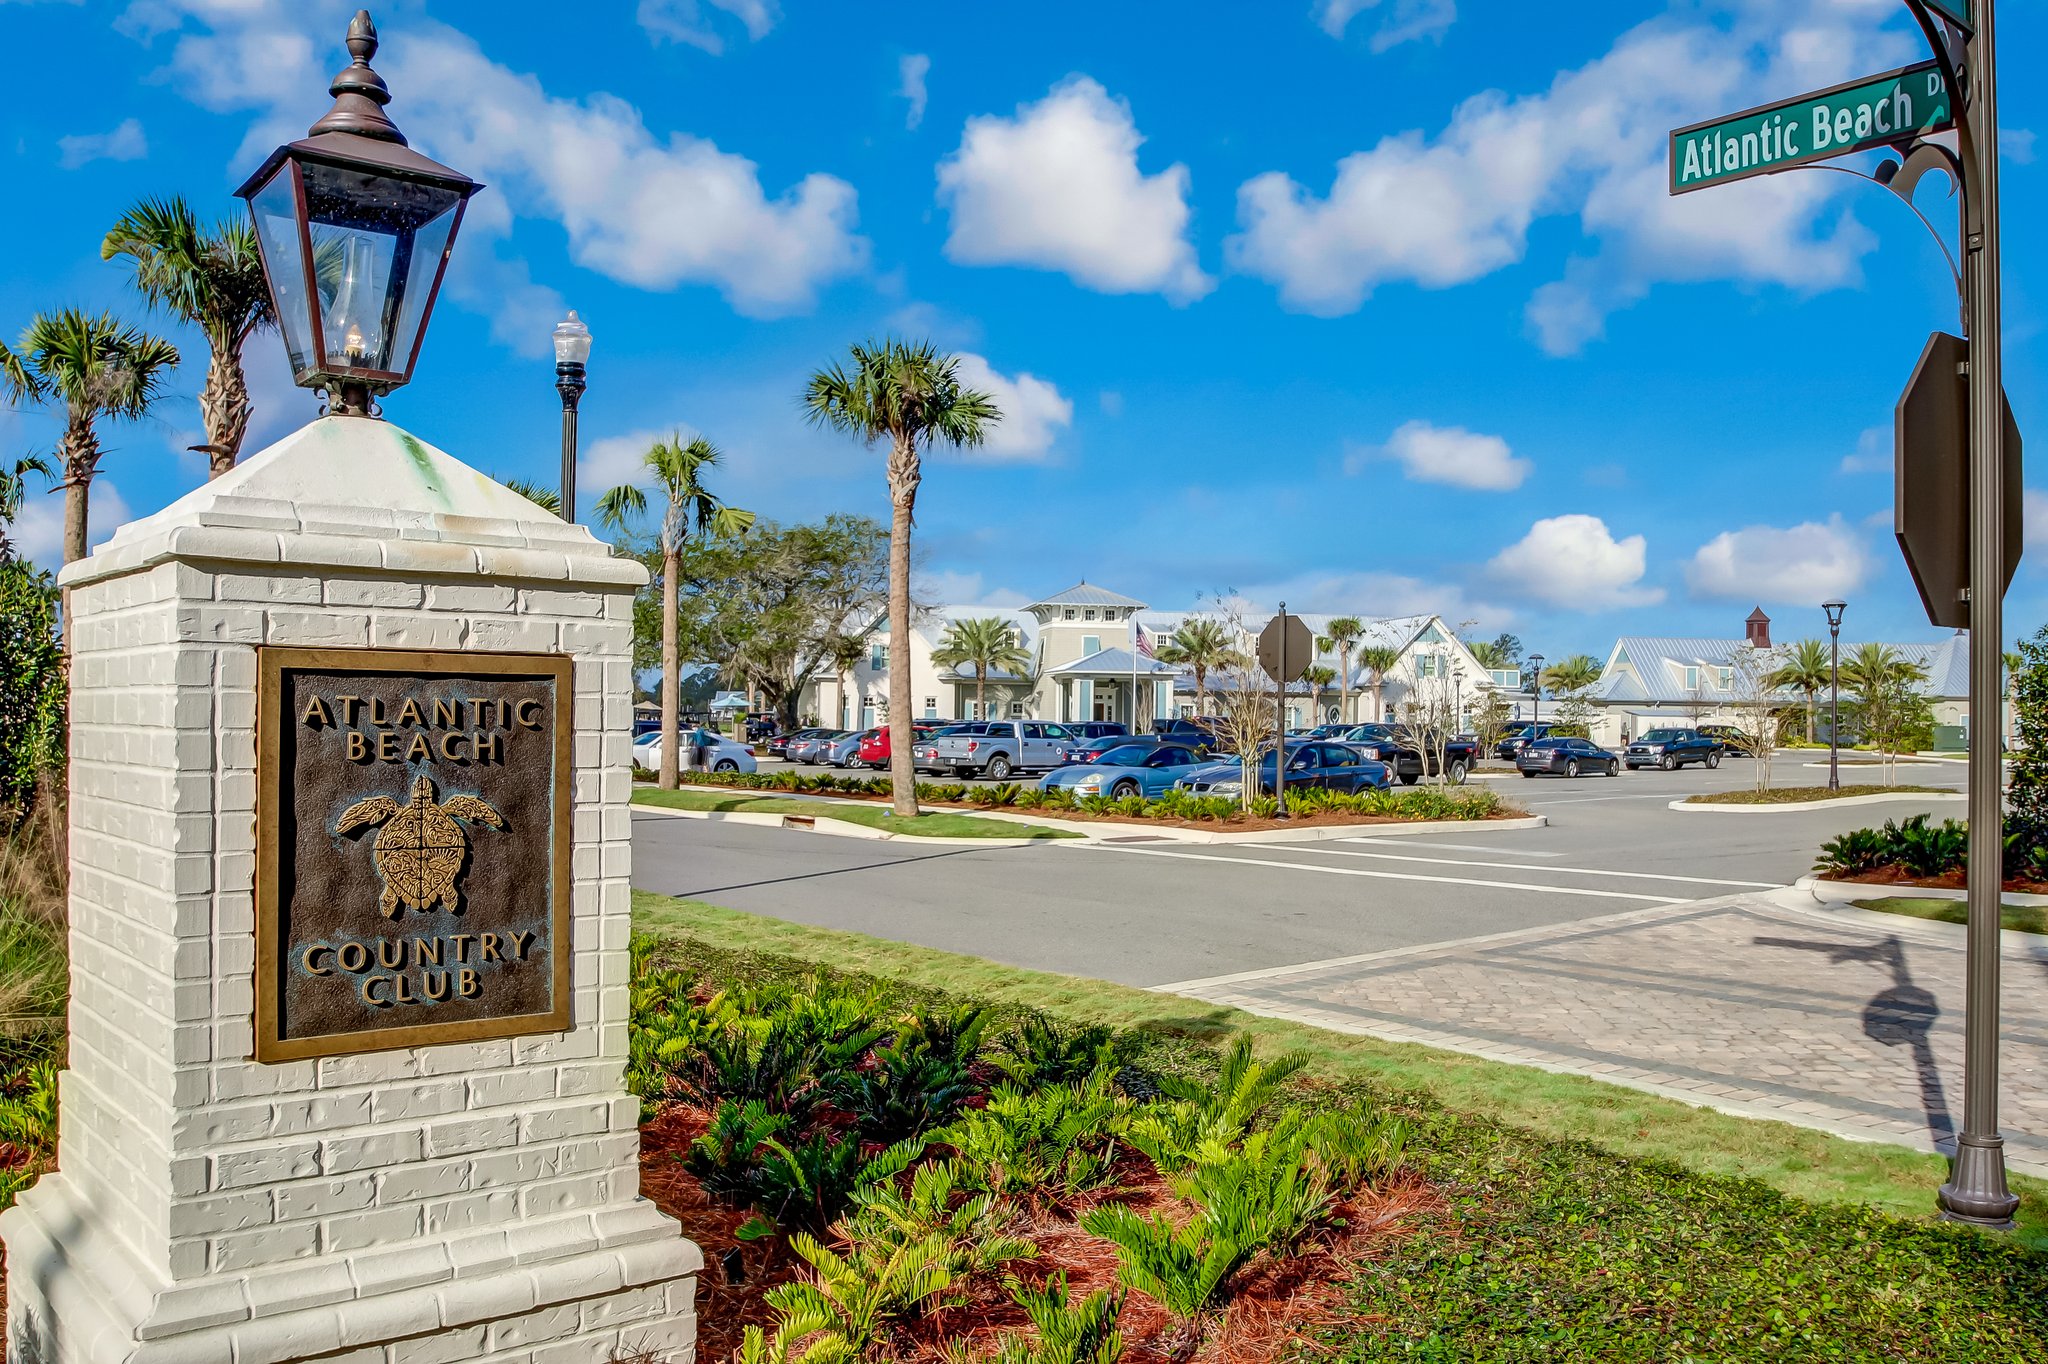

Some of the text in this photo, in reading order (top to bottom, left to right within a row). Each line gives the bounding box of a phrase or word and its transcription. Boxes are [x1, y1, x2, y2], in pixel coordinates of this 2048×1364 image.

[1682, 115, 1799, 182] Atlantic
[1812, 84, 1912, 150] Beach
[302, 695, 543, 726] ATLANTIC
[347, 731, 497, 761] BEACH
[303, 930, 530, 974] COUNTRY
[363, 968, 483, 1005] CLUB
